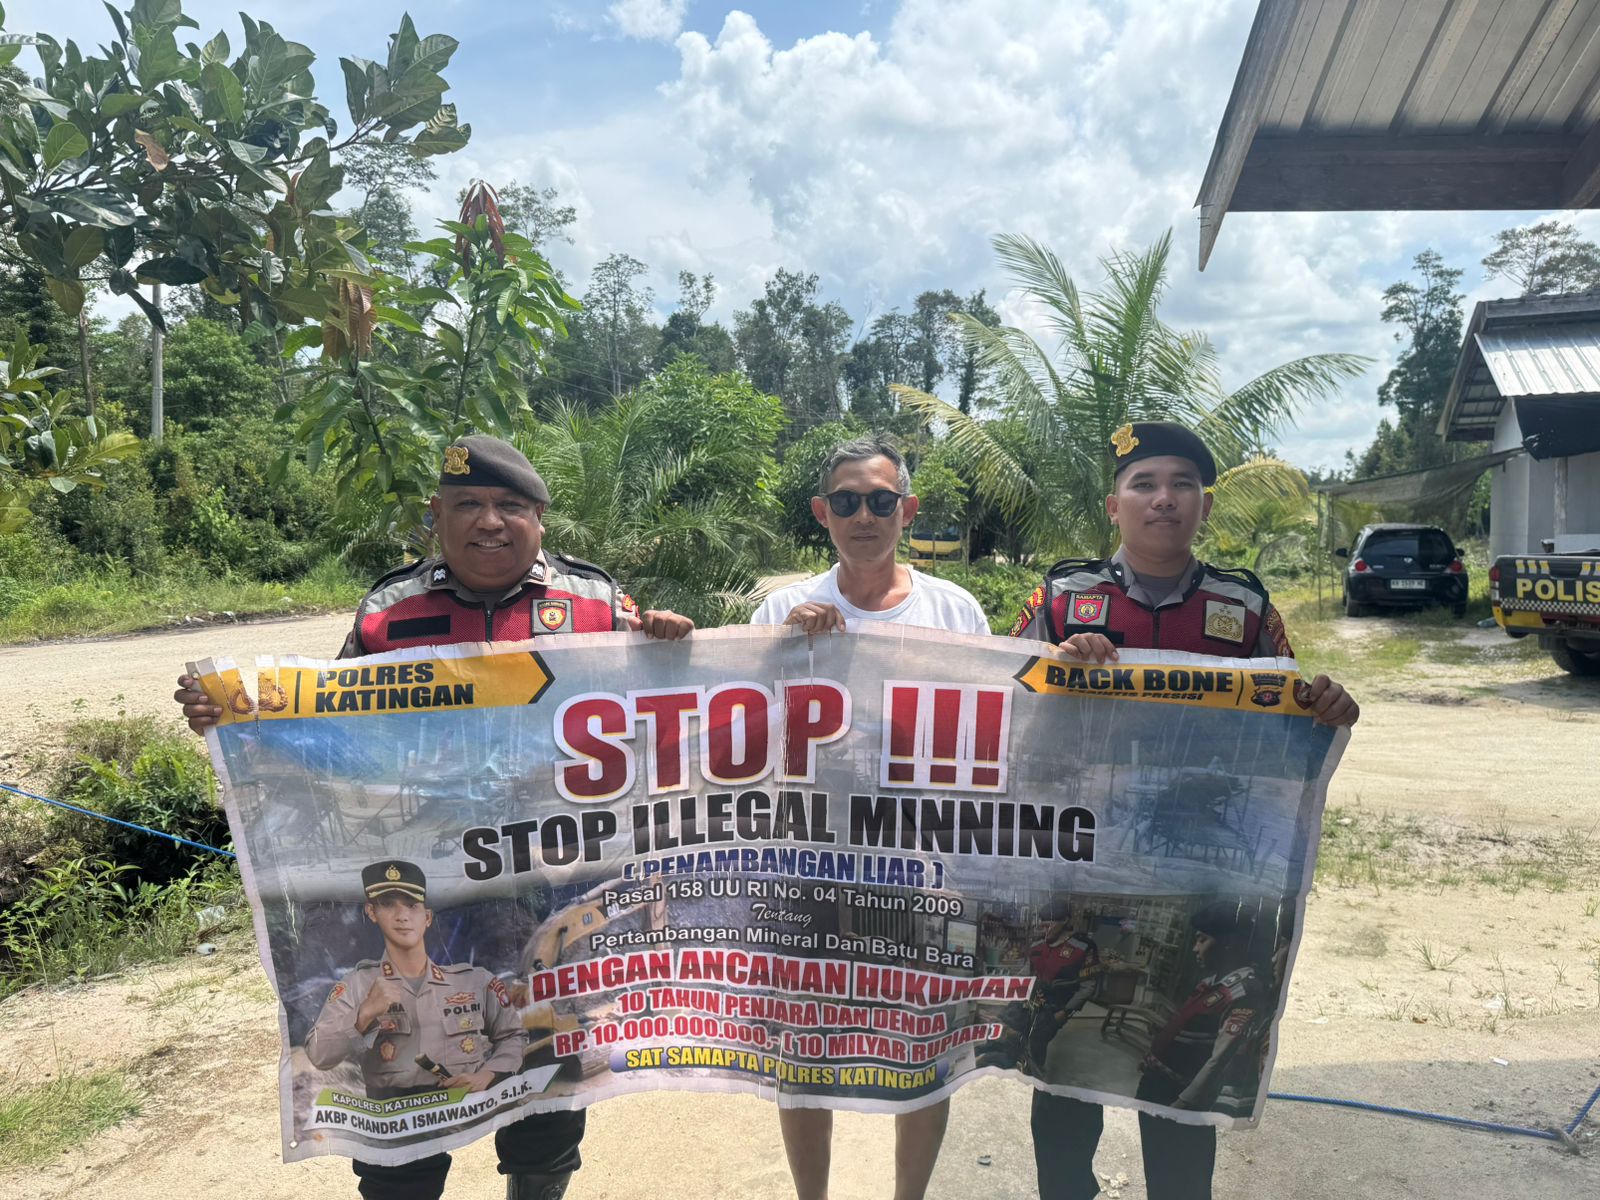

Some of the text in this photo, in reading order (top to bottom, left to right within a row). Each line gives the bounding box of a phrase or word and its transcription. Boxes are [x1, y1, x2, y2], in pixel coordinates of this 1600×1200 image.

[316, 662, 434, 689] POLRES
[1045, 664, 1135, 691] BACK
[1144, 669, 1233, 693] BONE
[315, 683, 474, 713] KATINGAN
[556, 680, 1008, 800] STOP !!!
[462, 790, 1097, 882] STOP ILLEGAL MINNING
[642, 847, 856, 879] PENAMBANGAN
[863, 854, 925, 888] LIAR
[604, 879, 962, 916] Pasal 158 UU RI No. 04 Tahun 2009
[752, 903, 813, 928] Tentang
[591, 927, 975, 969] Pertambangan Mineral Dan Batu Bara
[531, 950, 1035, 1006] DENGAN ANCAMAN HUKUMAN
[443, 1003, 480, 1017] POLRI
[618, 987, 947, 1037] 10 TAHUN PENJARA DAN DENDA
[554, 1031, 589, 1056] RP.
[827, 1033, 908, 1062] MILYAR
[626, 1045, 937, 1090] SAT SAMAPTA POLRES KATINGAN
[315, 1081, 533, 1135] AKBP CHANDRA ISMAWANTO, S.I.K.
[331, 1091, 449, 1114] KAPOLRES KATINGAN
